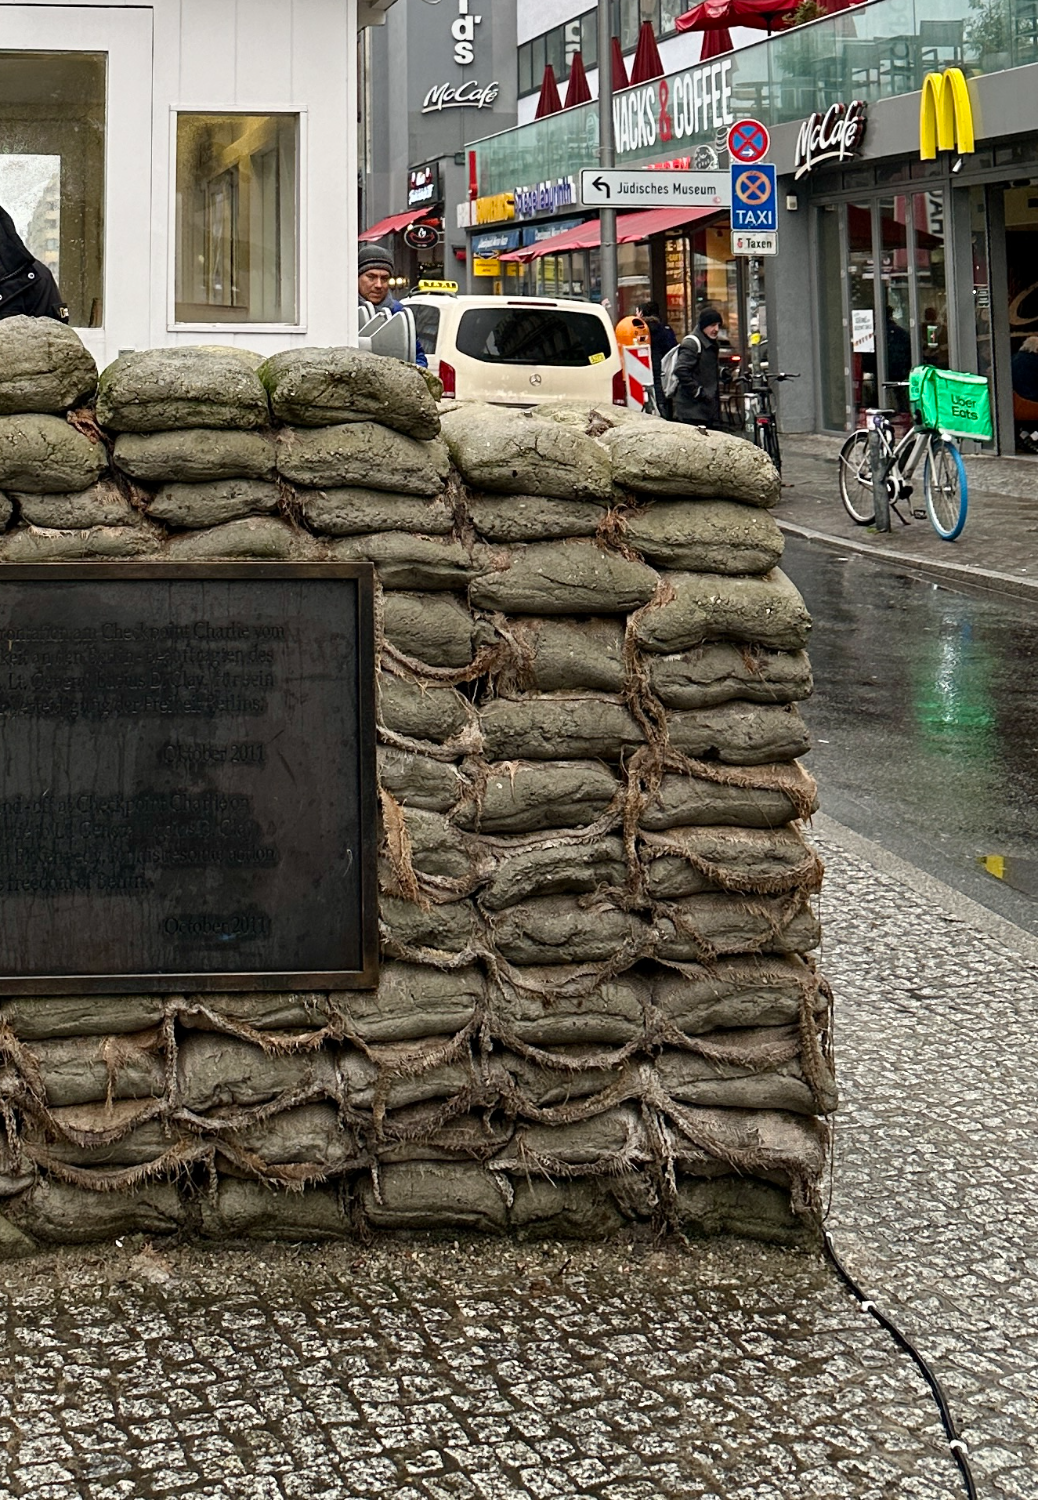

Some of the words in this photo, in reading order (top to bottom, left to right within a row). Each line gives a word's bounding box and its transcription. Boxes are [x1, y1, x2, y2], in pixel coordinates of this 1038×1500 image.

[424, 80, 499, 109] McCafé
[658, 79, 673, 142] &
[673, 59, 734, 139] COFFEE
[794, 100, 859, 172] McCafé
[617, 181, 669, 195] Jüdisches
[673, 183, 716, 195] Museum
[735, 210, 772, 225] TAXI
[746, 238, 772, 249] Taxen
[951, 394, 977, 408] Uber
[951, 406, 978, 421] Eats
[101, 621, 190, 644] Checkpoint
[193, 620, 250, 641] Charlie
[253, 624, 286, 640] vom
[231, 743, 264, 763] 2011
